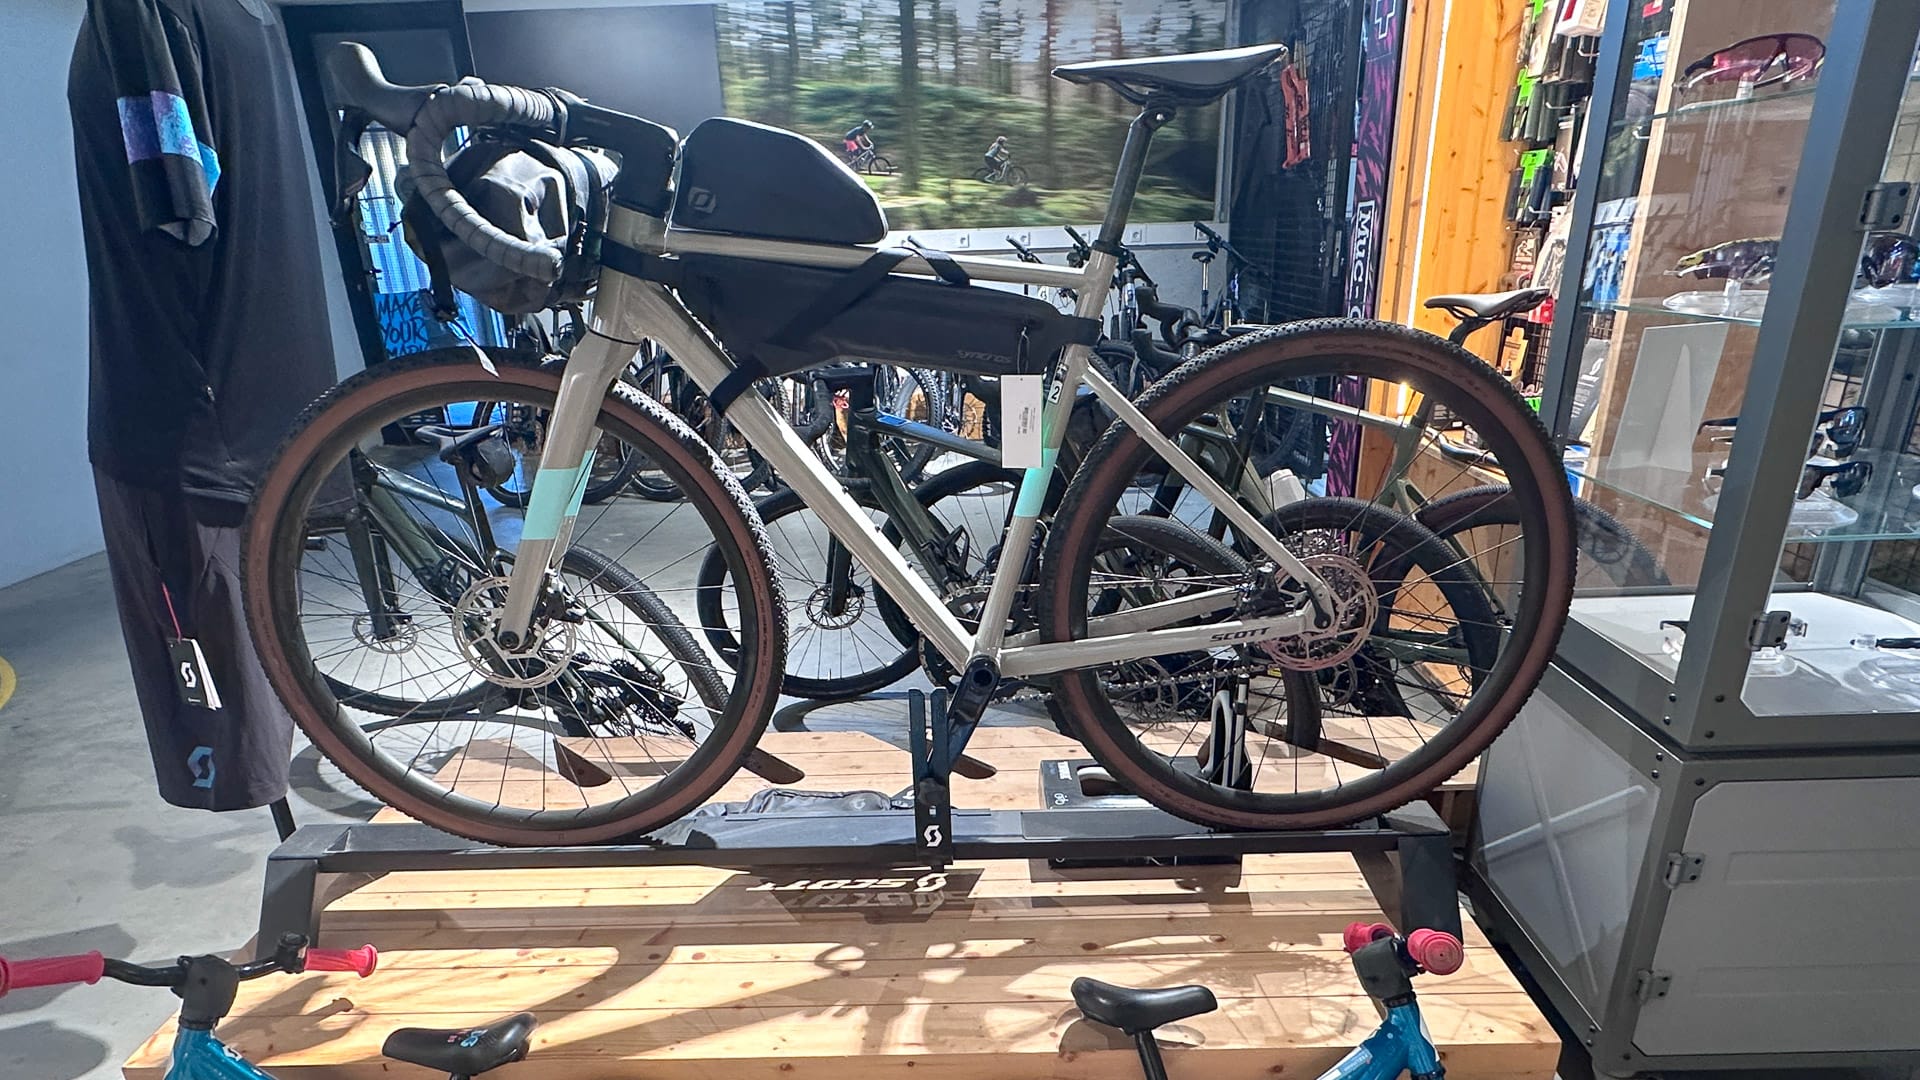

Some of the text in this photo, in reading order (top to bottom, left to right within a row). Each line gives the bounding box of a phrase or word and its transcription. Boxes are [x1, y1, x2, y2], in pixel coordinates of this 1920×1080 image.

[378, 293, 422, 321] MAKE
[379, 317, 428, 345] YOUR
[1209, 626, 1271, 642] SCOTT
